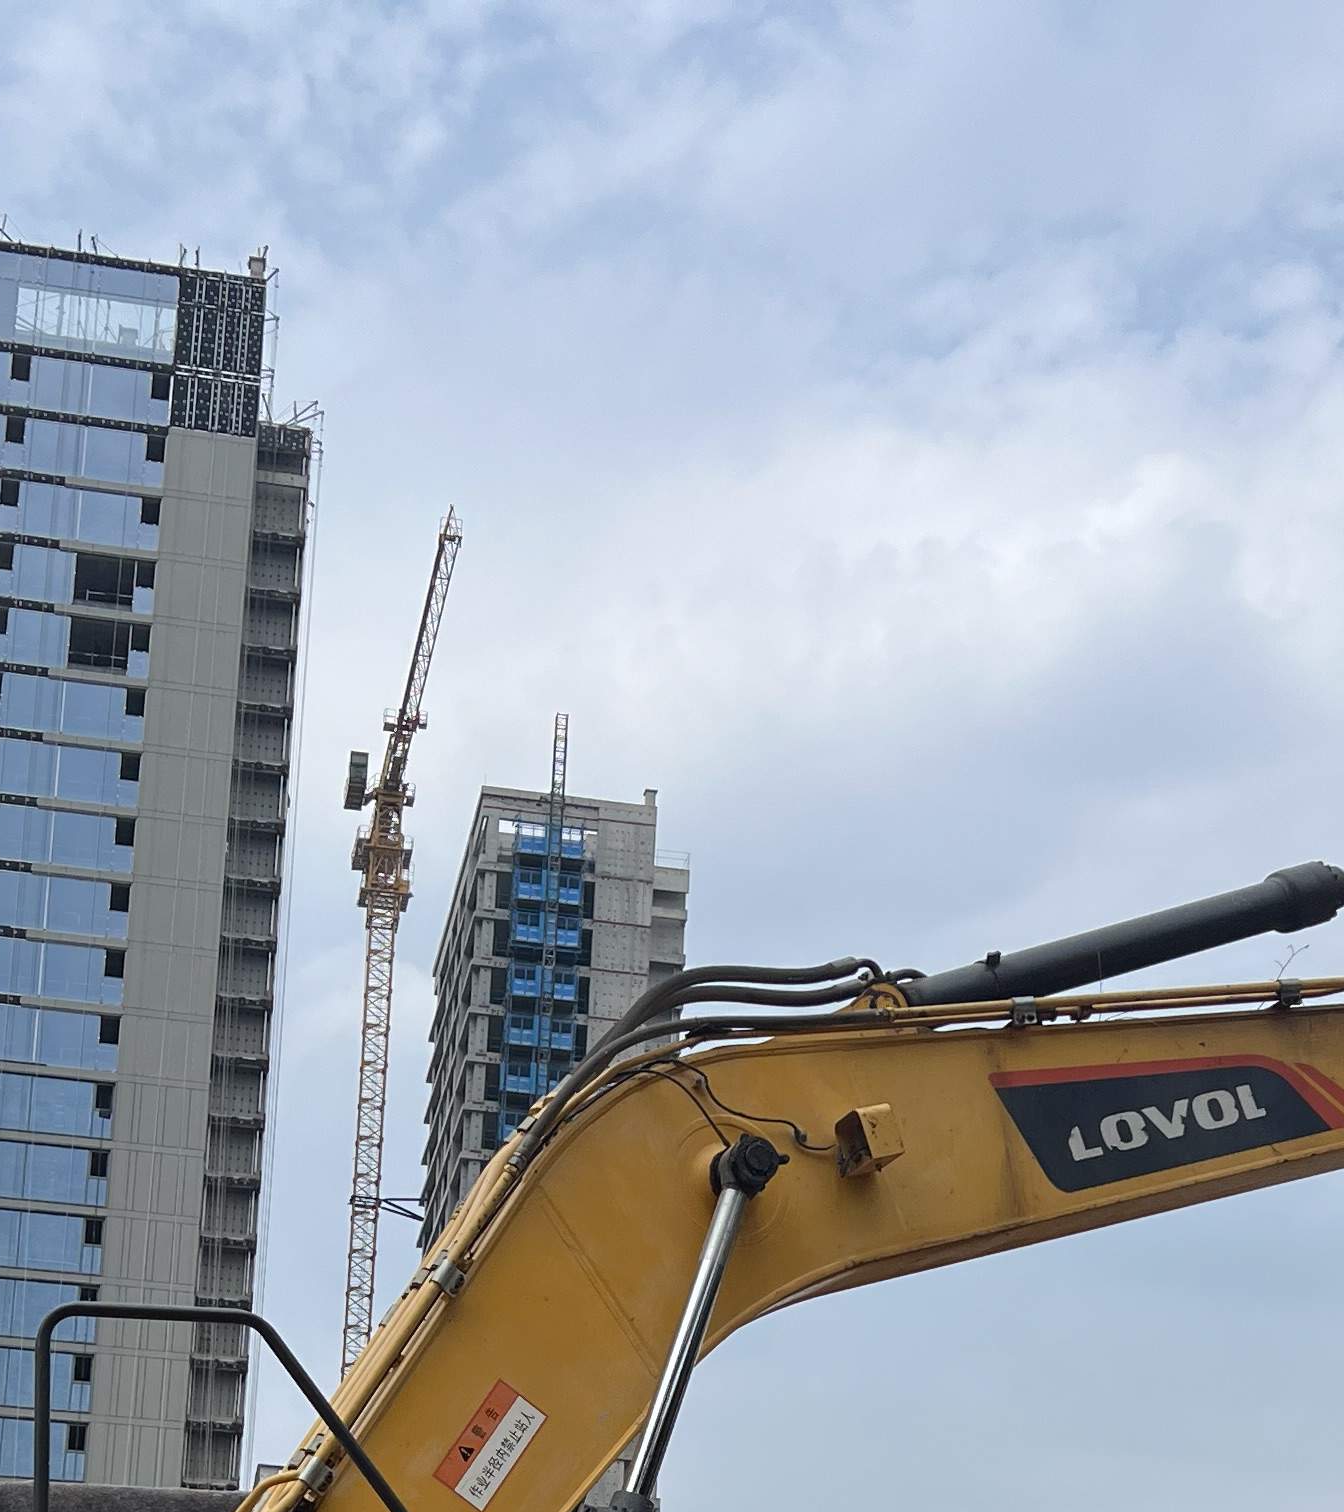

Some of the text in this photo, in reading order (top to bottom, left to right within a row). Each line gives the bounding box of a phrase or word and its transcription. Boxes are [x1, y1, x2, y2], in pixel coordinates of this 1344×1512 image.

[1067, 1084, 1266, 1162] LOVOL
[469, 1411, 536, 1499] 作业半径内禁止站人
